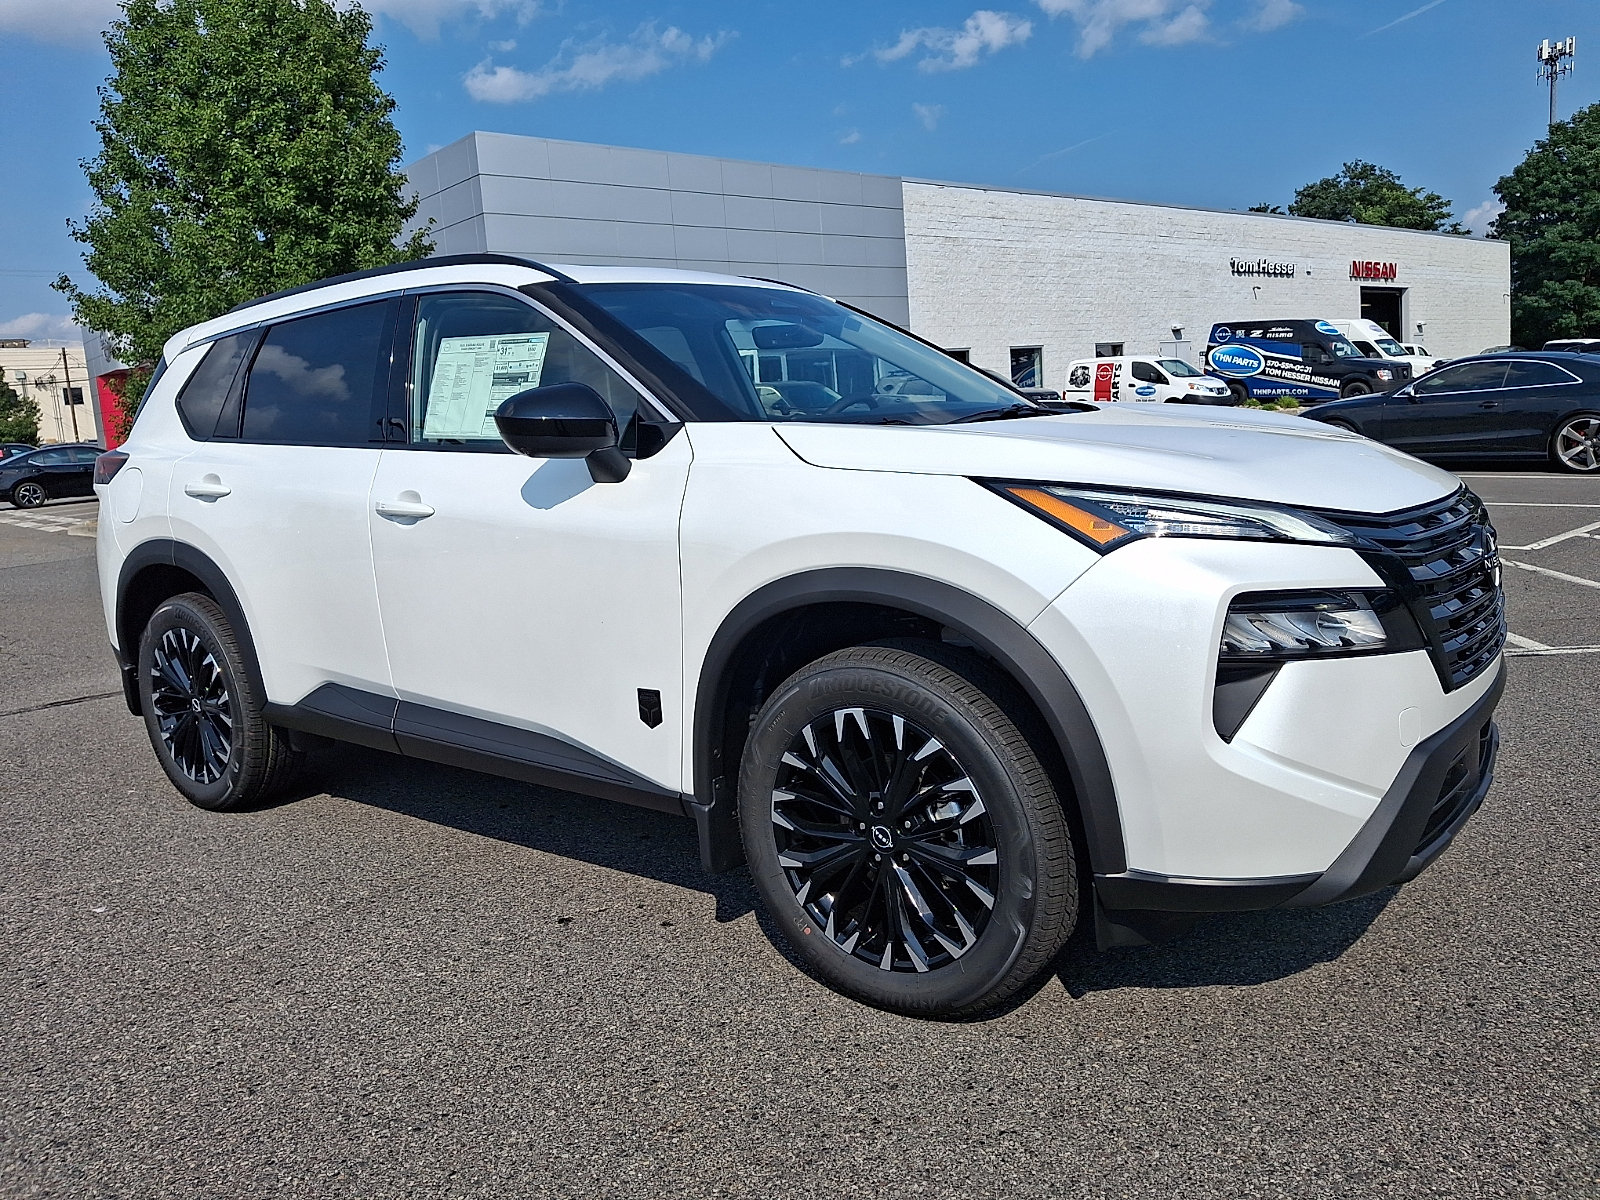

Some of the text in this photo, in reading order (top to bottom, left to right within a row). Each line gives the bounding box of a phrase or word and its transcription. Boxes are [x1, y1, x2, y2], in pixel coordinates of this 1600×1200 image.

[1232, 257, 1256, 272] Tom
[1352, 260, 1397, 278] NISSAN
[1214, 352, 1259, 368] THN PARTS
[1111, 363, 1122, 402] ARTS
[1265, 367, 1341, 387] TOM HESSER NISSAN
[1252, 388, 1308, 396] THNPARTS.COM
